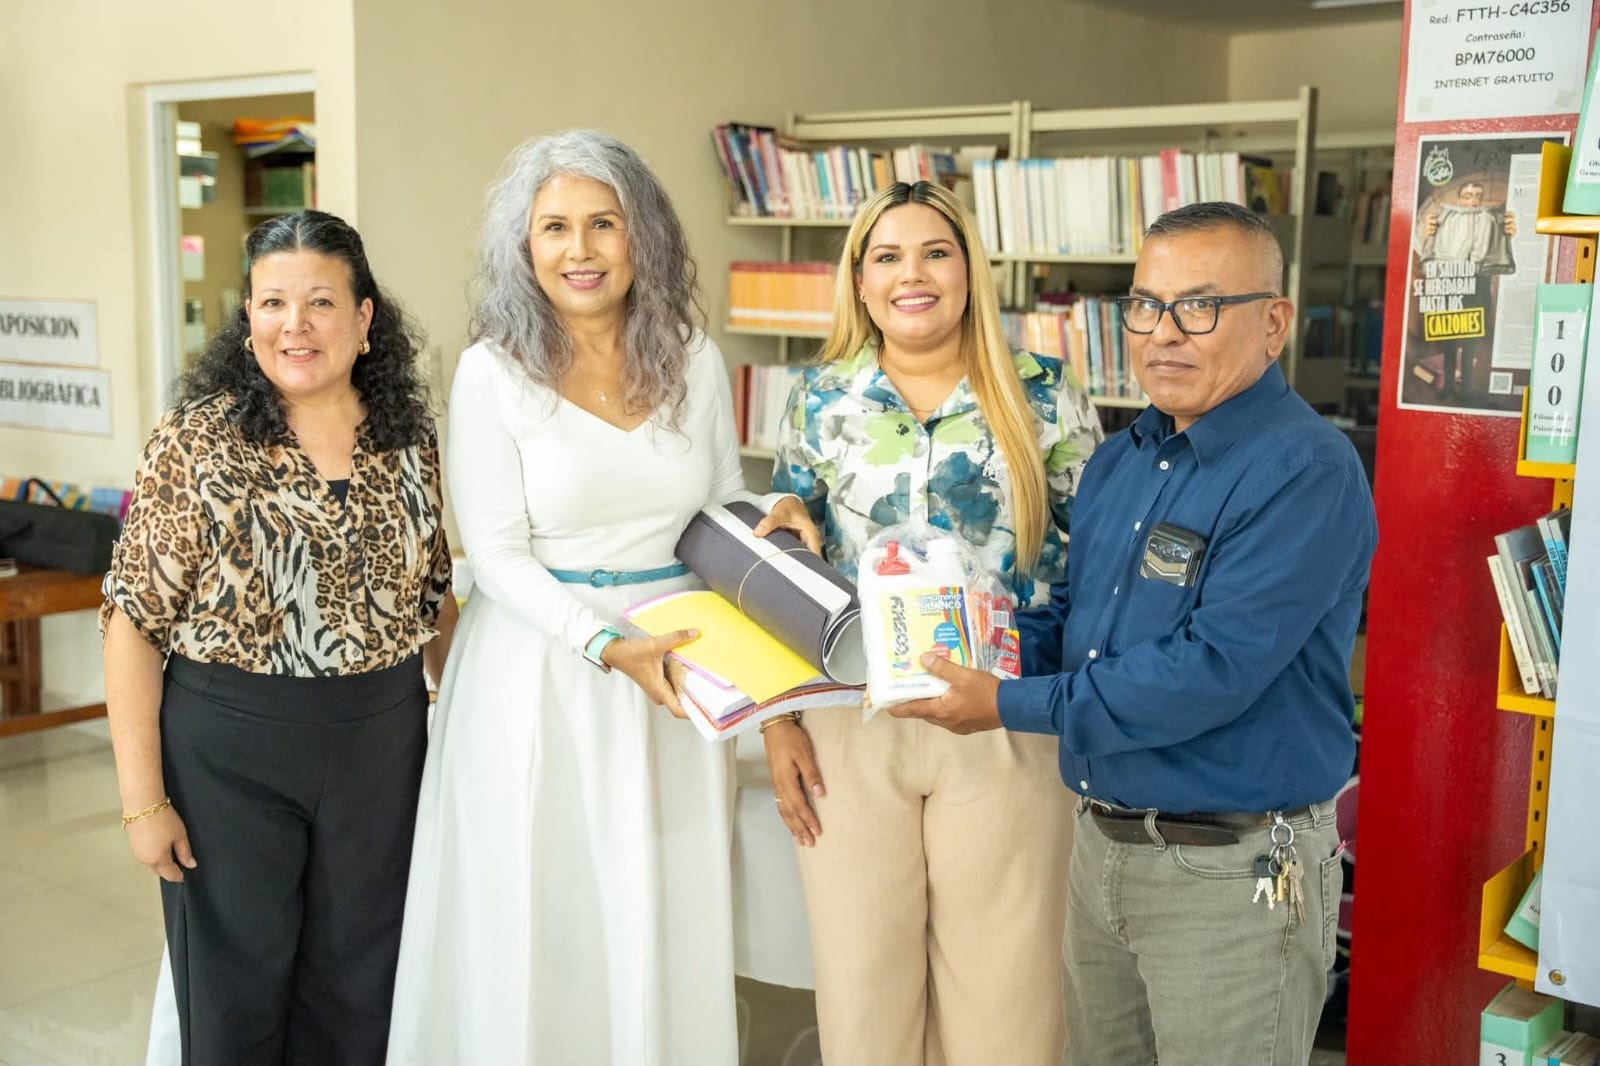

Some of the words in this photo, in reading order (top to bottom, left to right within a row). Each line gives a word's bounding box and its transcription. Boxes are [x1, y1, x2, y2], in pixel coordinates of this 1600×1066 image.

[1429, 14, 1451, 25] Red:
[1456, 0, 1570, 22] FTTH-C4C356
[1466, 30, 1526, 43] Contraseña:
[1455, 47, 1536, 66] BPM76000
[1434, 76, 1489, 89] INTERNET
[1494, 71, 1554, 86] GRATUITO
[1413, 279, 1424, 296] SE
[1425, 277, 1476, 295] HEREDABAN
[1419, 295, 1446, 313] HASTA
[1448, 295, 1464, 310] LOS
[1429, 312, 1480, 335] CALZONES
